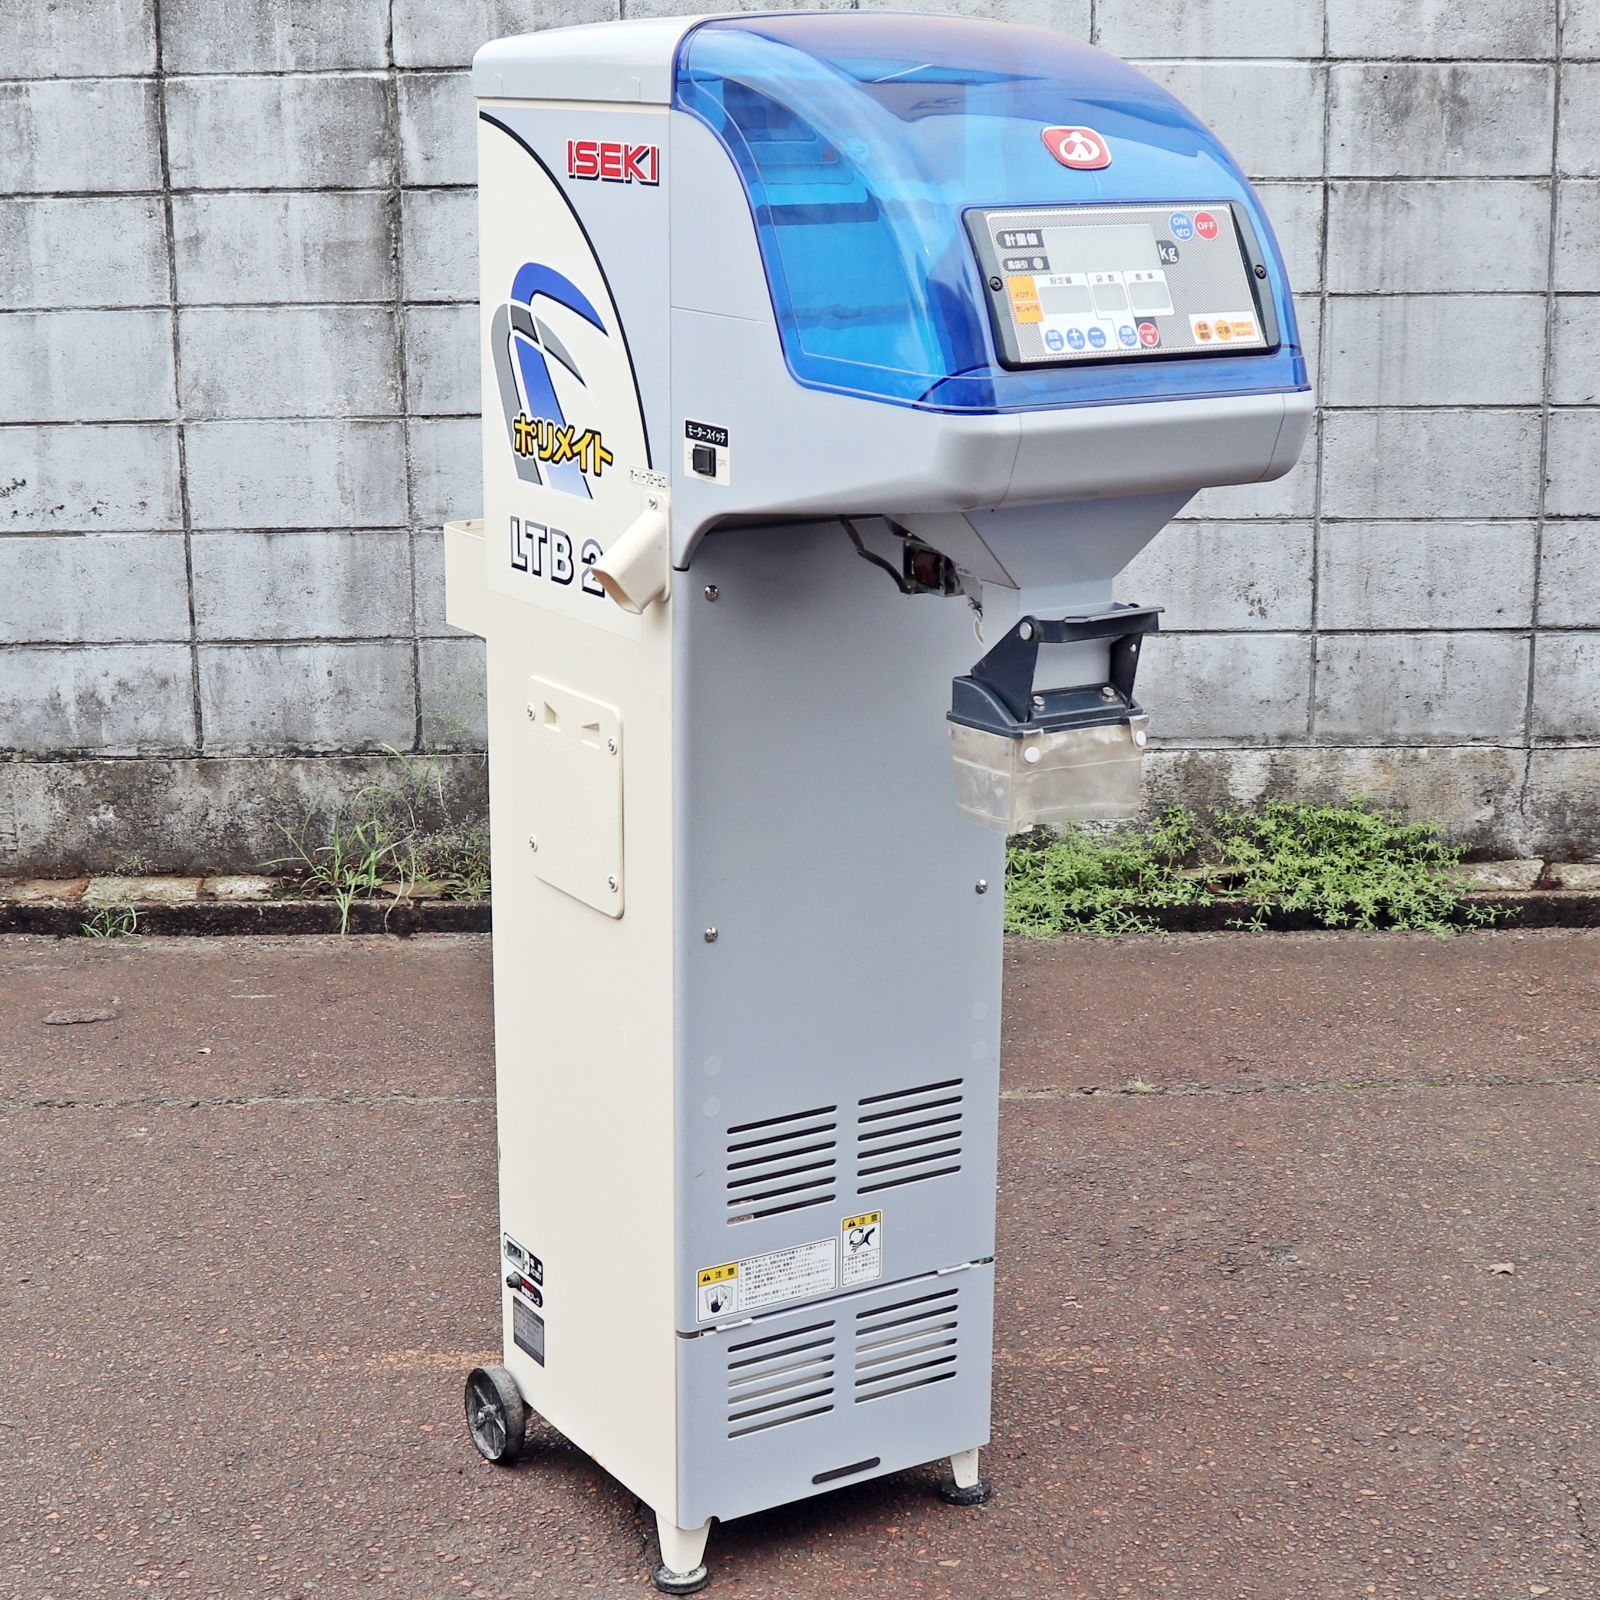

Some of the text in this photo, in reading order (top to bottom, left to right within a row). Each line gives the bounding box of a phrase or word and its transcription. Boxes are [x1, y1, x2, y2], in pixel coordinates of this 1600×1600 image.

[567, 138, 660, 186] ISEKI
[1173, 216, 1188, 227] ON
[1197, 221, 1215, 231] OFF
[1004, 232, 1039, 246] 計量値
[1158, 244, 1178, 262] kg
[687, 424, 726, 444] モータースイッチ
[512, 412, 614, 478] ポリメイト
[510, 515, 575, 586] LTB
[715, 1267, 735, 1279] 注意
